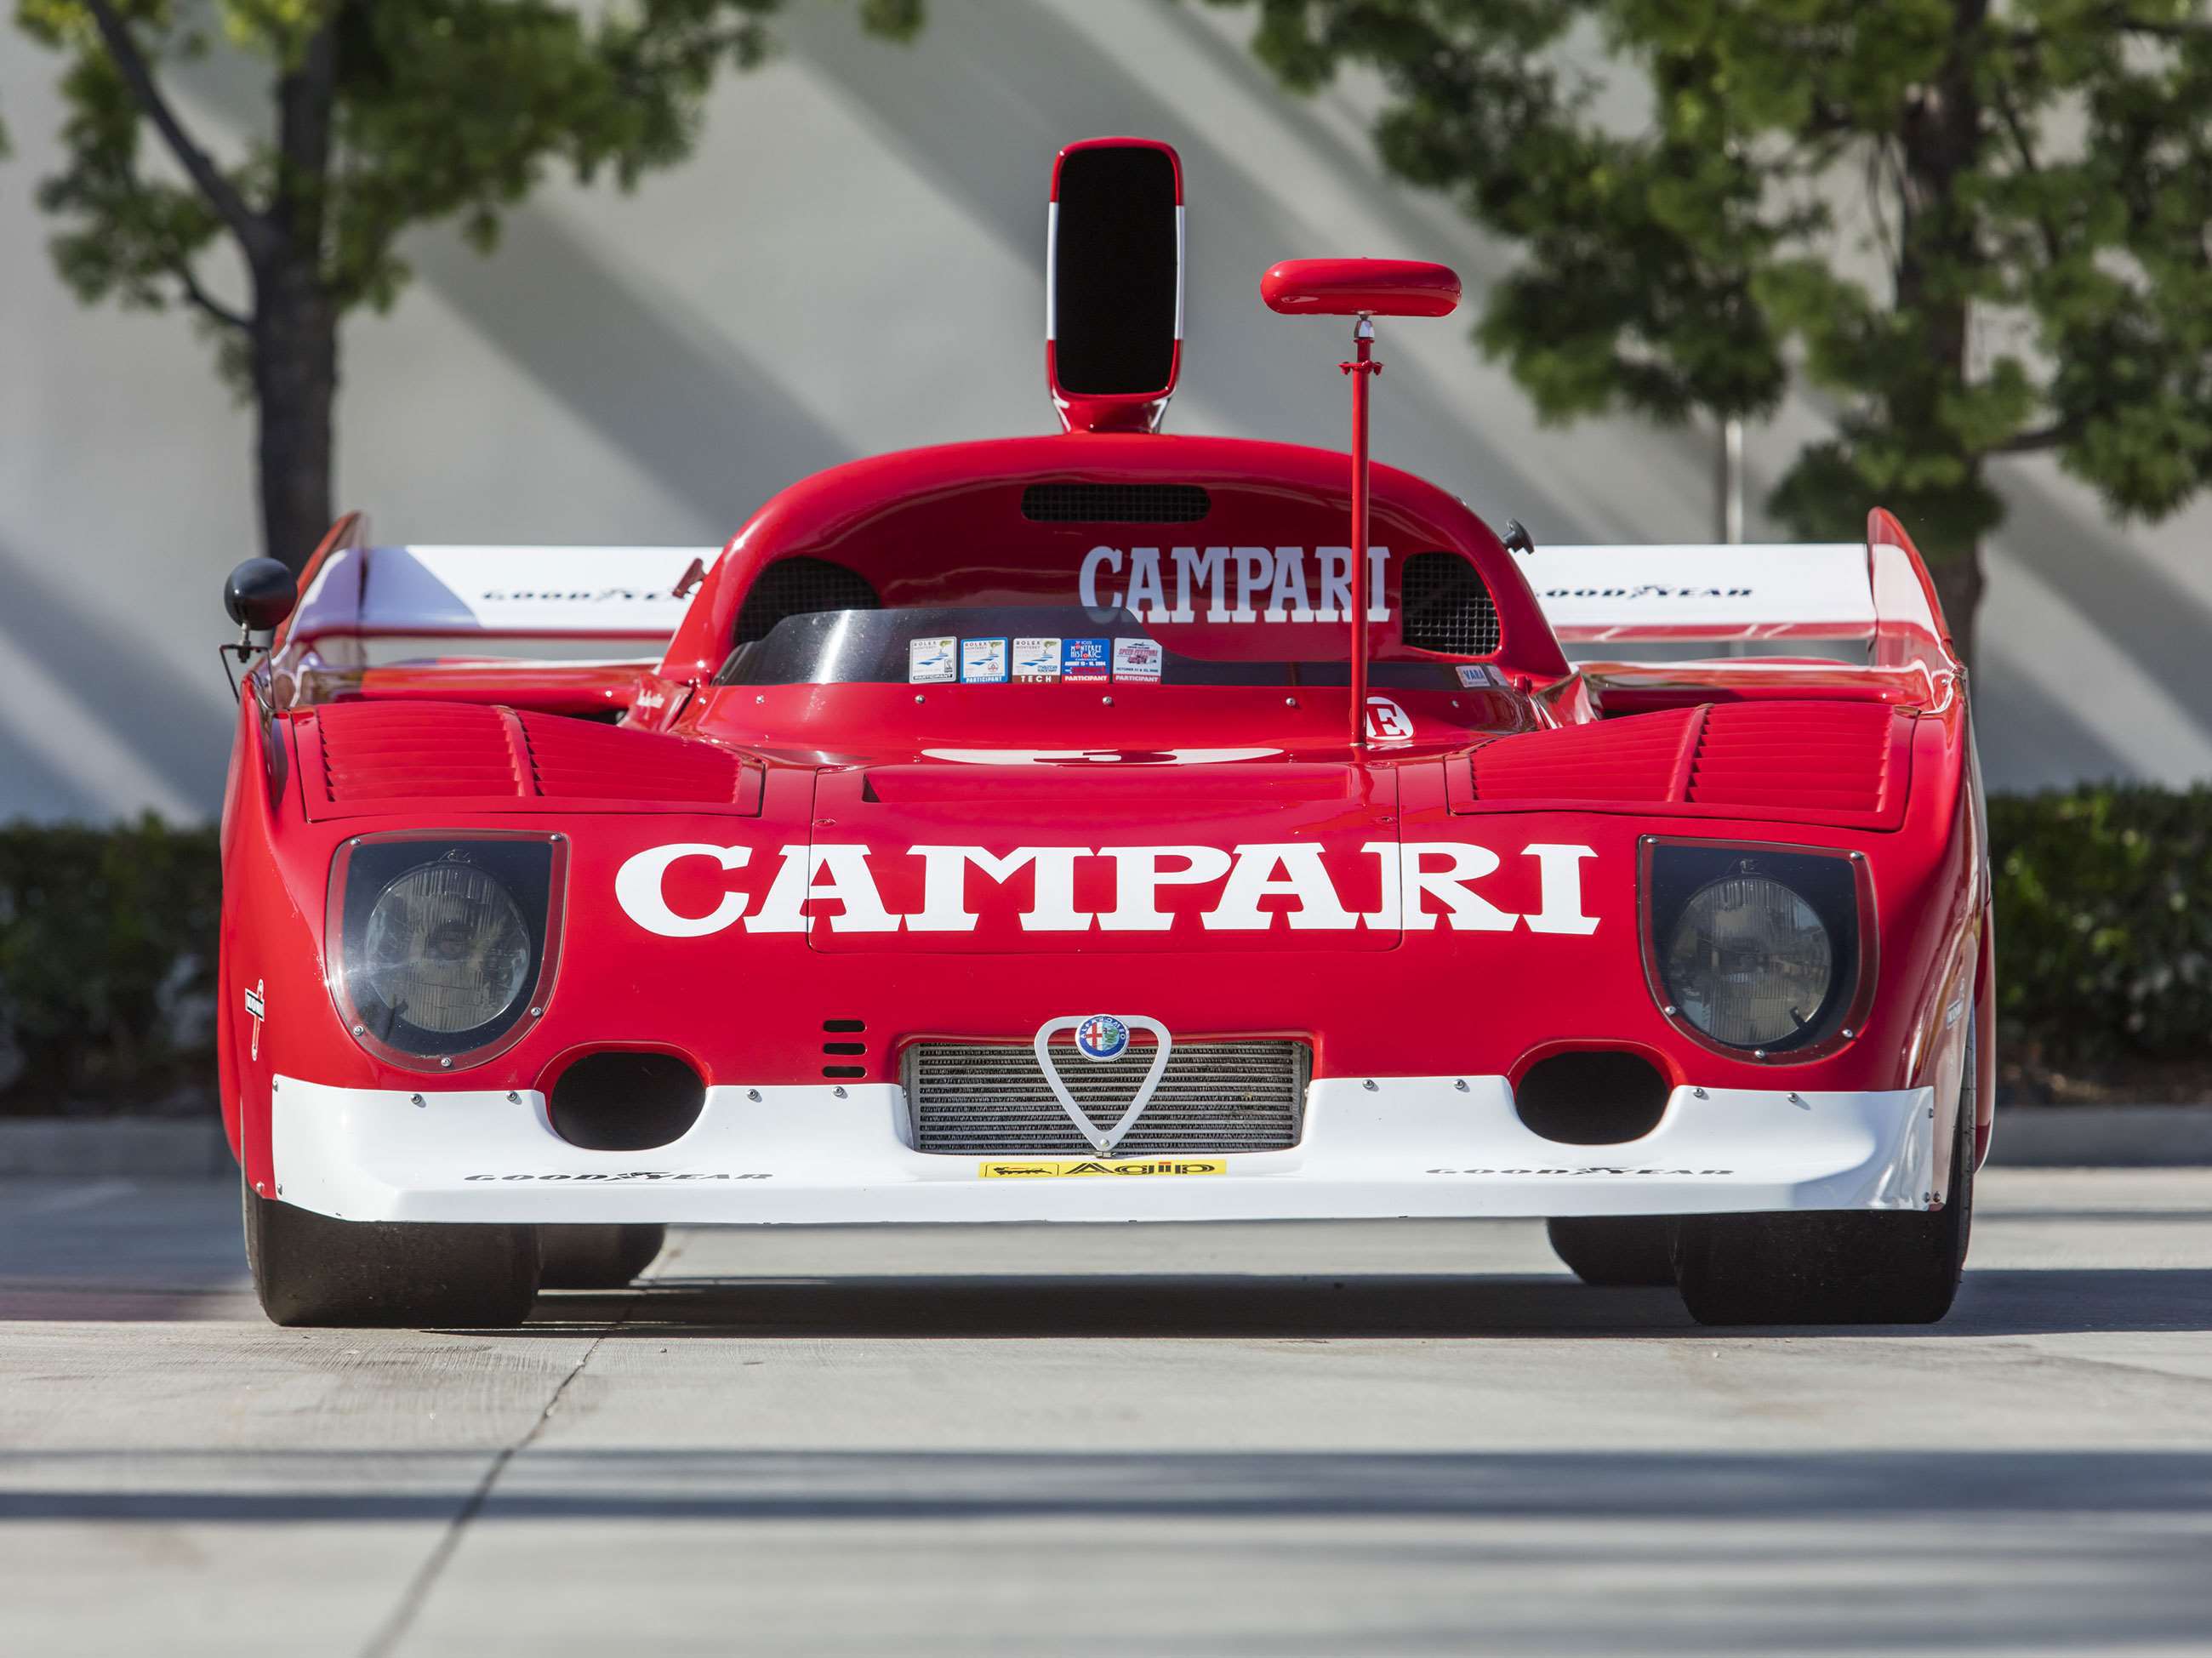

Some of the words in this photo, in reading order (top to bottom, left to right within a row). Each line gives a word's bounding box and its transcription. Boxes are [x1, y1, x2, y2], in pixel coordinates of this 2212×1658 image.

[1079, 545, 1391, 624] CAMPARI
[1535, 584, 1752, 599] OODYEAR
[615, 842, 1599, 936] CAMPARI
[464, 1171, 772, 1181] GOODYEAR
[1064, 1161, 1216, 1176] Agip
